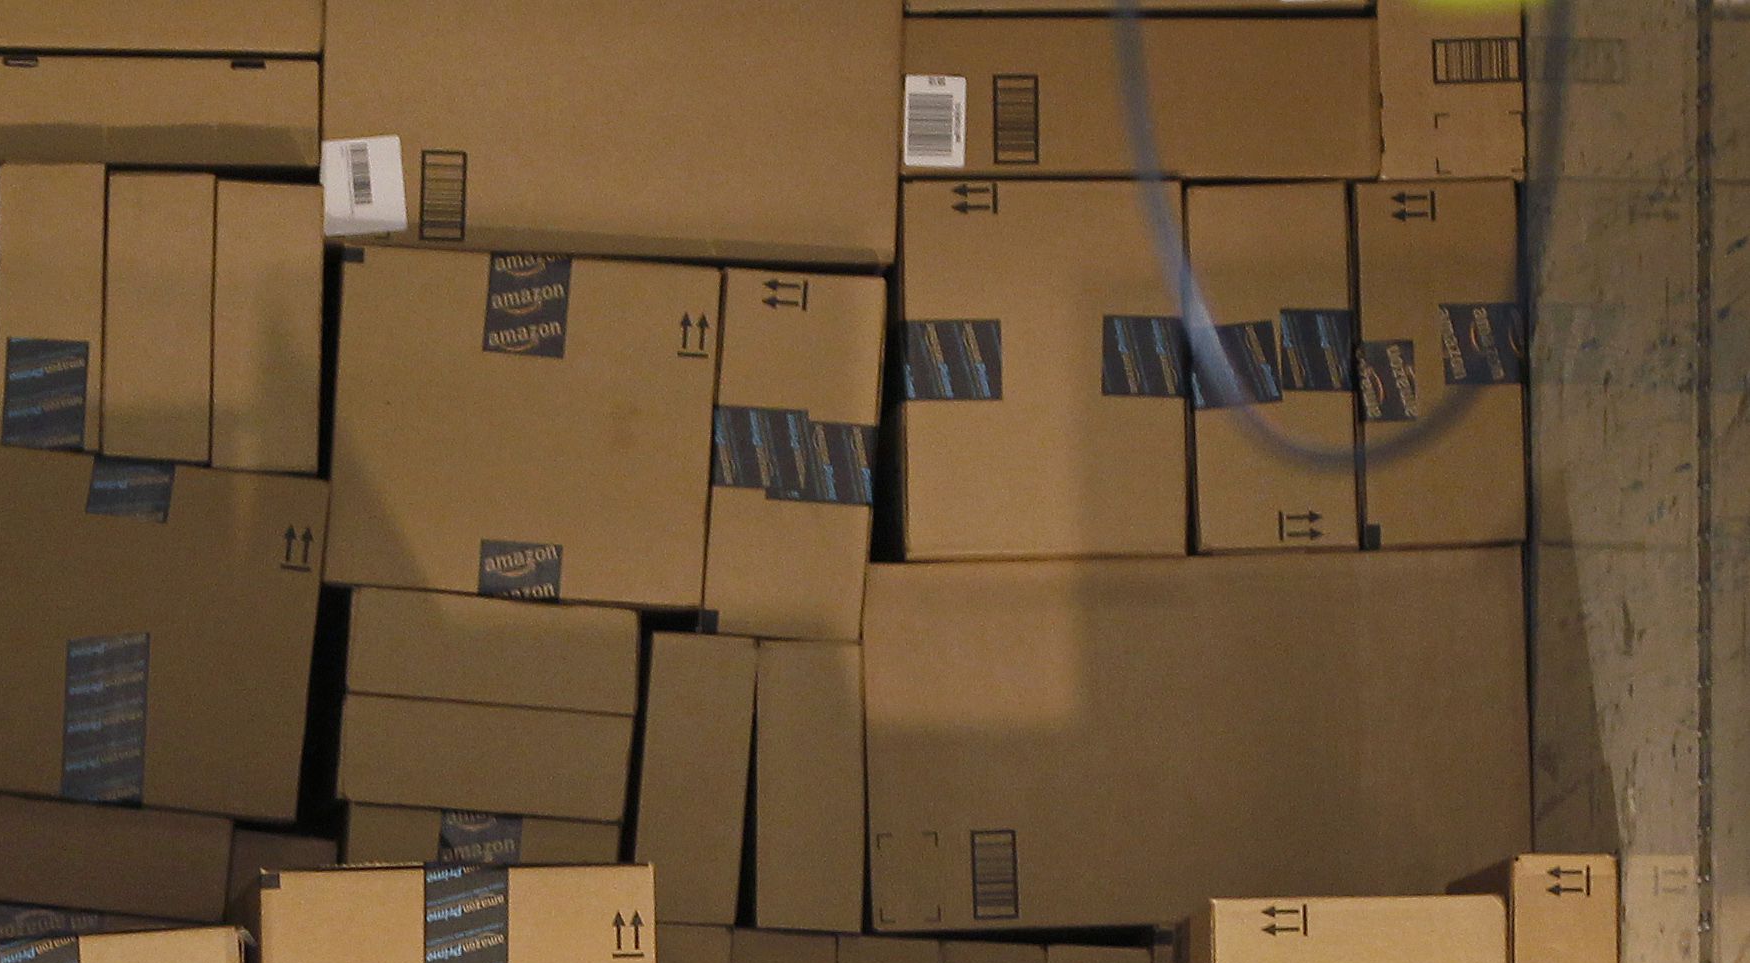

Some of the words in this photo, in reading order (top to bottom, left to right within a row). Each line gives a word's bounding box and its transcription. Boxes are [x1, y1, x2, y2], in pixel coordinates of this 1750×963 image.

[492, 284, 565, 308] amazon
[489, 322, 561, 345] amazon
[485, 544, 558, 571] amazon
